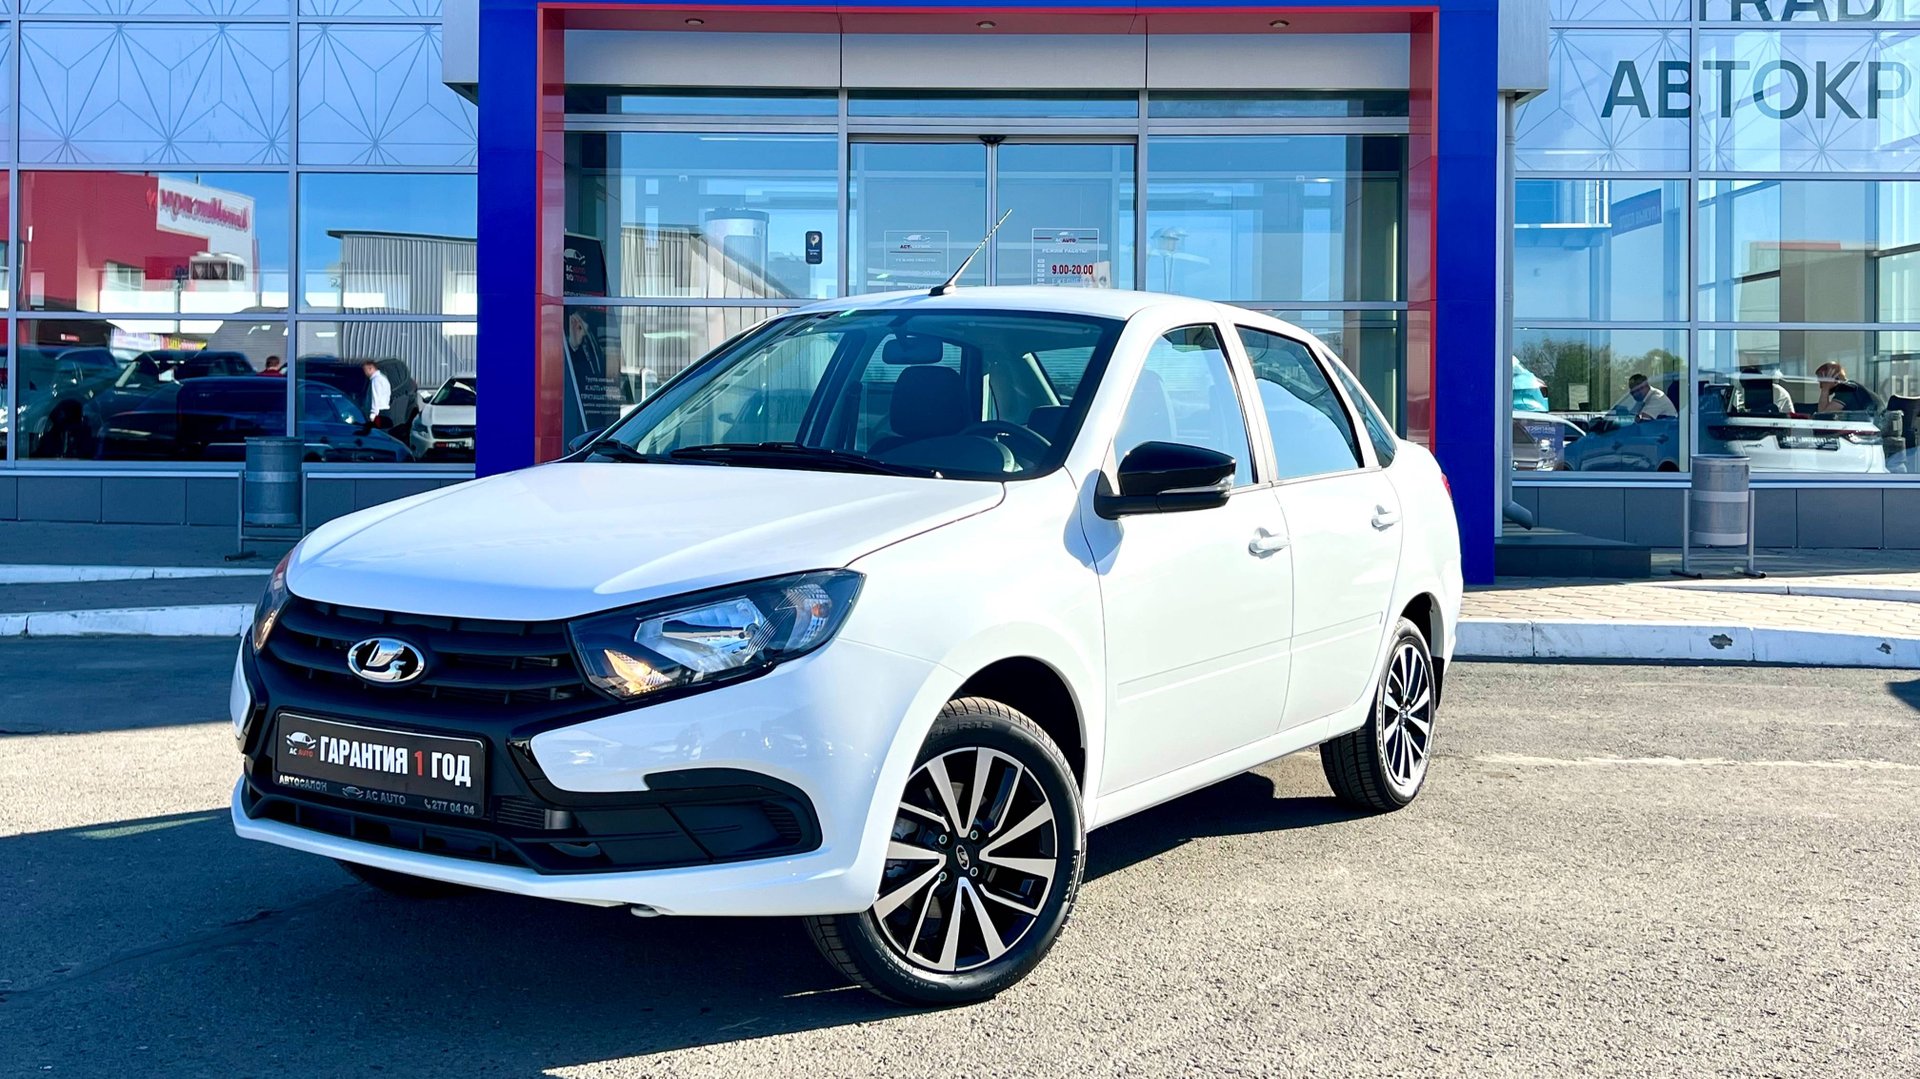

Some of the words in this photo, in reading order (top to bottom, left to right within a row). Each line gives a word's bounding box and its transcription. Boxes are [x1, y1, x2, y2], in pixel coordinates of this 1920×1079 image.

[1601, 60, 1920, 119] АВТОКР
[1052, 264, 1093, 275] 9.00-20.00
[289, 747, 298, 755] AC
[298, 748, 314, 757] AUTO
[320, 736, 408, 774] ГАРАНТИЯ
[414, 751, 423, 776] 1
[431, 752, 471, 787] ГОД
[279, 774, 327, 791] АВТОСАЛОН
[366, 790, 379, 802] AC
[380, 792, 406, 805] AUTO
[431, 800, 448, 810] 277
[450, 803, 461, 813] 04
[463, 805, 475, 815] 04
